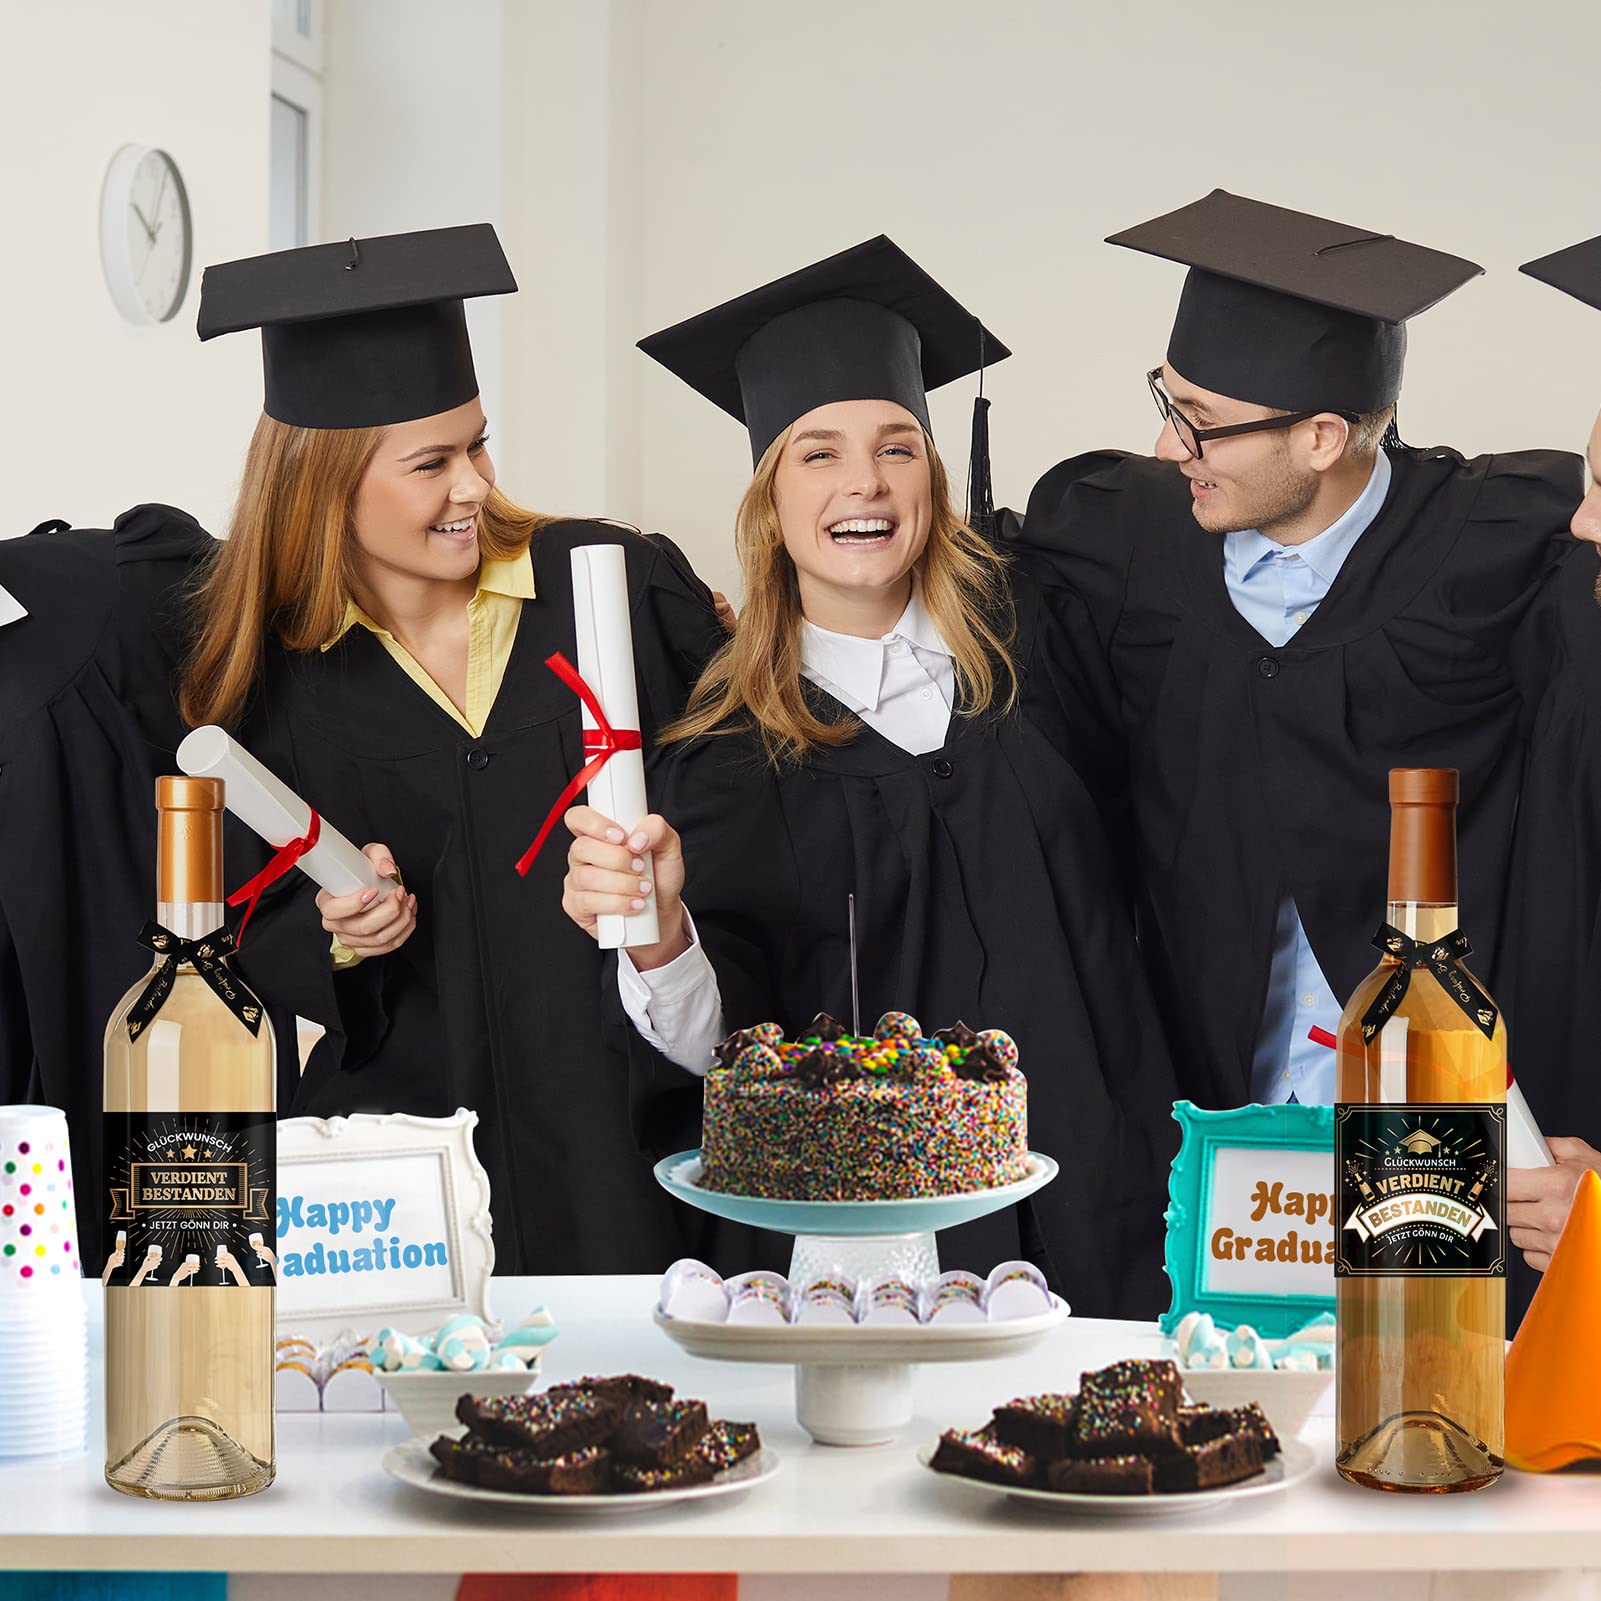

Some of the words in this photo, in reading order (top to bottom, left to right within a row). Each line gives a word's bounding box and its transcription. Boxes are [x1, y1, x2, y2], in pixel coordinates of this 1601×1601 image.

[147, 1132, 233, 1153] GLÜCKWUNSCH
[1384, 1157, 1456, 1167] GLÜCKWUNSCH
[150, 1171, 228, 1184] VERDIENT
[1375, 1173, 1465, 1195] VERDIENT
[142, 1187, 237, 1201] BESTANDEN
[276, 1195, 396, 1238] Happy
[1367, 1199, 1473, 1229] BESTANDEN
[149, 1221, 177, 1230] JETZT
[180, 1219, 211, 1230] GÖNN
[213, 1221, 230, 1230] DIR
[1386, 1230, 1411, 1245] JETZT
[1412, 1227, 1437, 1238] GÖNN
[1439, 1232, 1454, 1243] DIR
[277, 1236, 448, 1277] aduation
